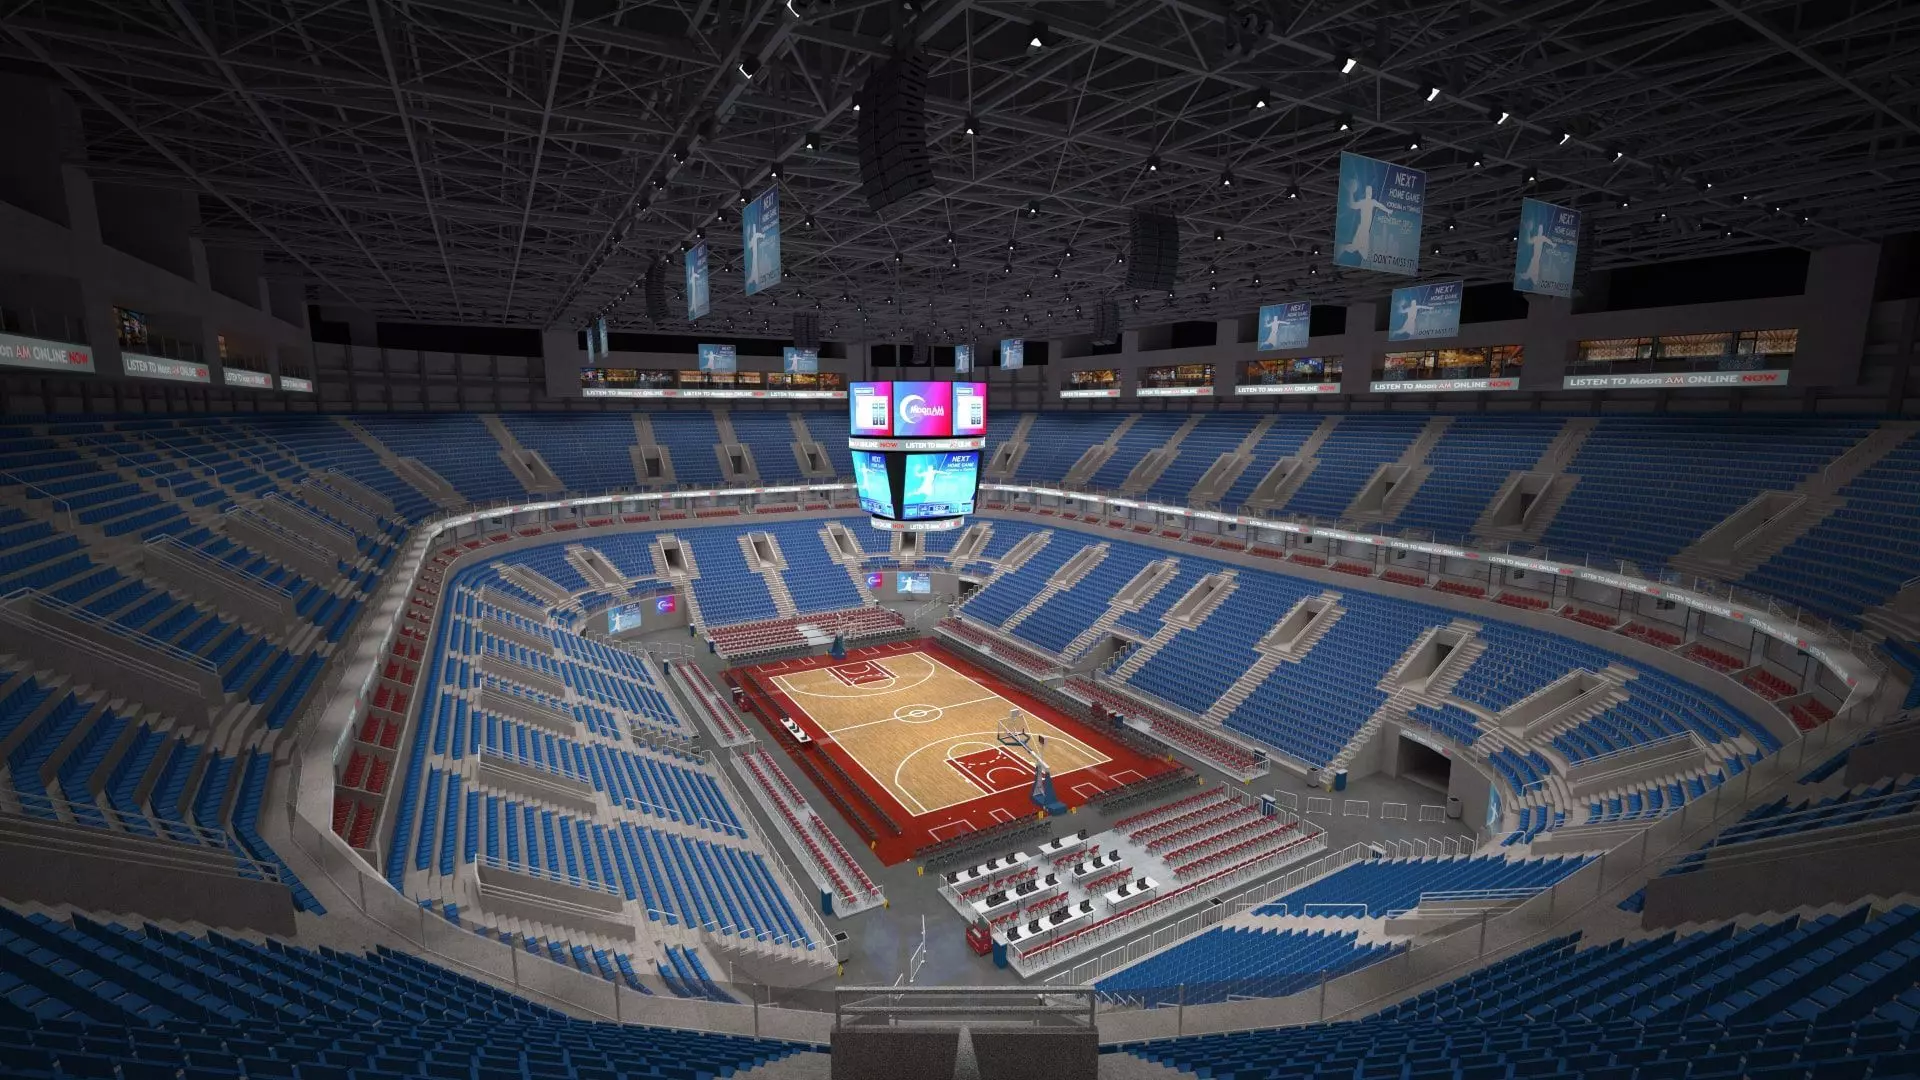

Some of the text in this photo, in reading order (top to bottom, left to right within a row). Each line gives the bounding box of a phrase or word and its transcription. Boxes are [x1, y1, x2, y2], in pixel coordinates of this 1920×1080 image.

[1395, 172, 1416, 188] NEXT
[1389, 188, 1420, 203] HOME GAME
[1559, 212, 1574, 225] NEXT
[1435, 285, 1455, 294] NEXT
[1291, 304, 1305, 312] NEXT
[16, 345, 31, 358] AM
[33, 346, 68, 364] ONLINE
[68, 352, 88, 364] NOW
[126, 360, 147, 372] LISTEN
[148, 362, 156, 373] TO
[1570, 378, 1607, 386] LISTEN
[1630, 377, 1662, 385] Moon
[1664, 376, 1684, 384] AM
[1688, 375, 1738, 383] ONLINE
[1742, 373, 1778, 382] NOW
[1391, 541, 1409, 549] LISTEN
[1488, 556, 1505, 564] LISTEN
[1538, 564, 1559, 573] ONLINE
[1666, 592, 1684, 602] LISTEN
